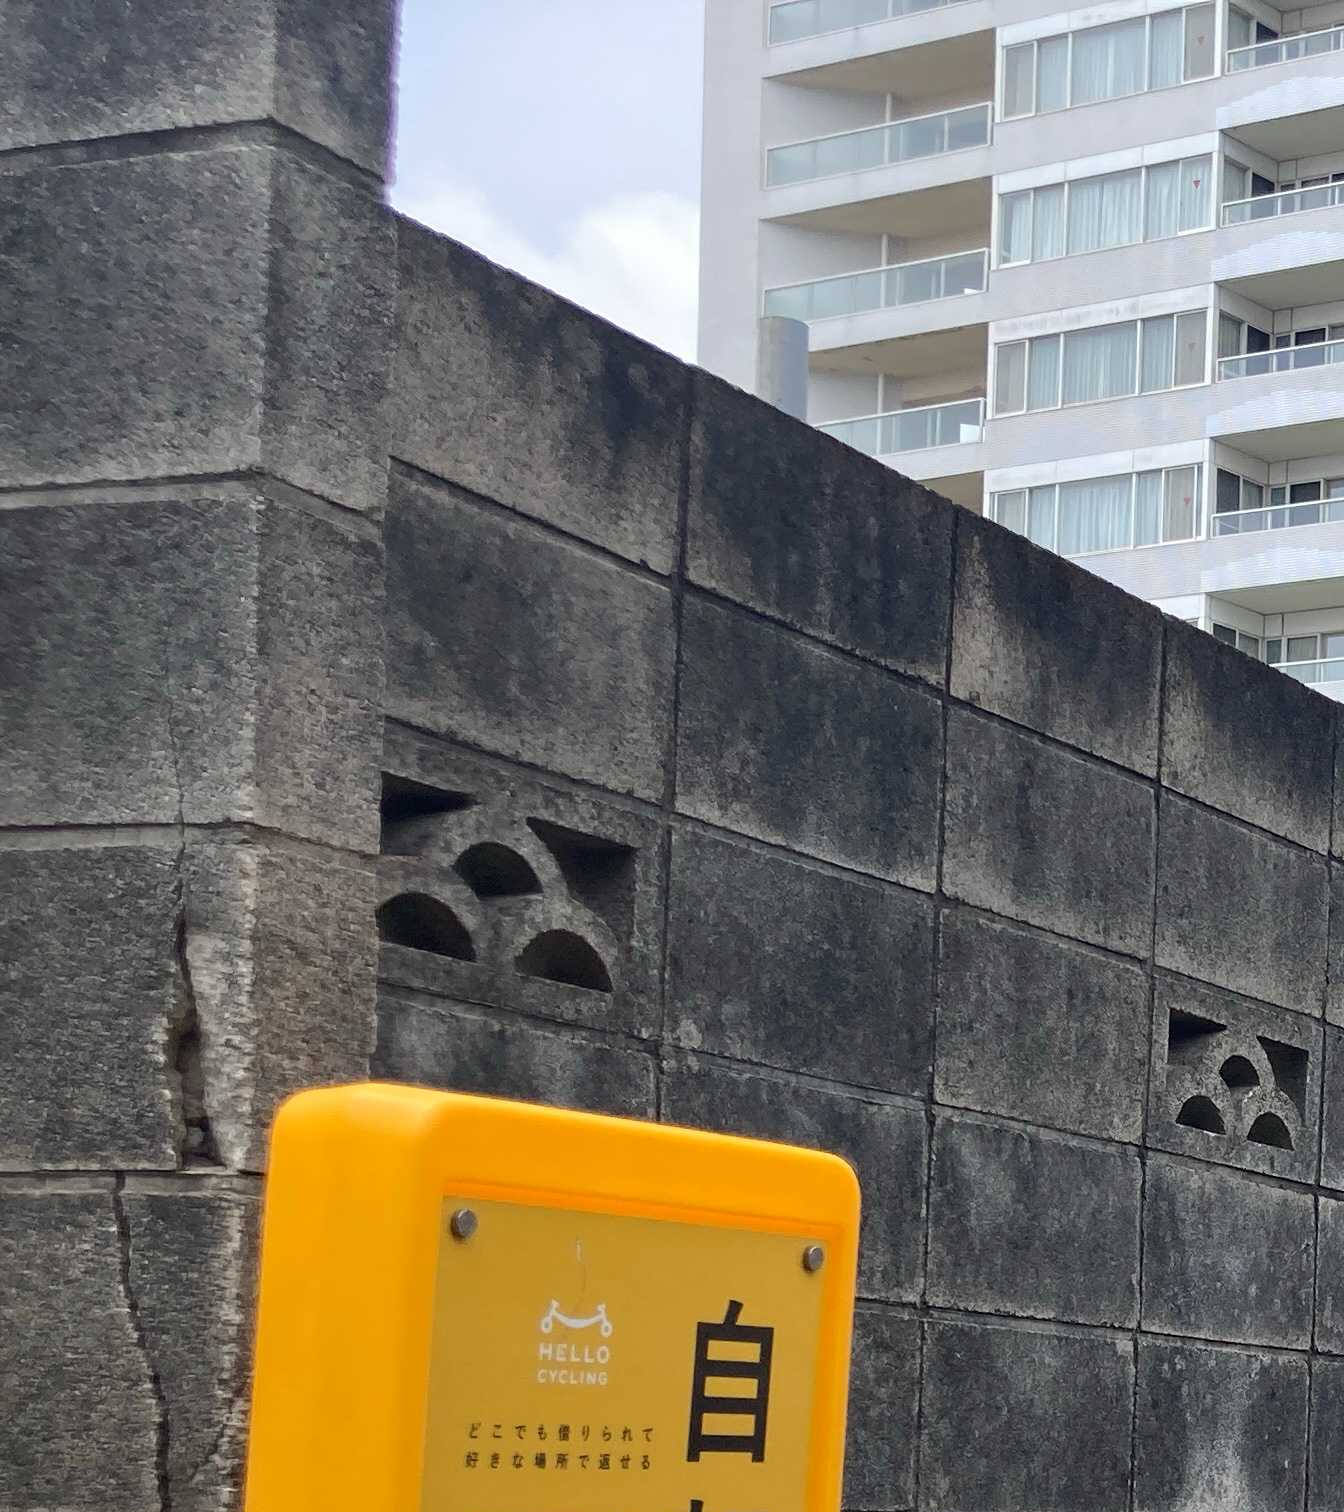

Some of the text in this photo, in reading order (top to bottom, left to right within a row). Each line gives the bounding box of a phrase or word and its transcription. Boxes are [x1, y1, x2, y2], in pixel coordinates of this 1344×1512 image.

[538, 1343, 610, 1364] HELLO
[537, 1369, 608, 1386] CYCLING
[468, 1422, 653, 1442] どこでも借りられて
[465, 1451, 650, 1470] 好きな場所で返せる
